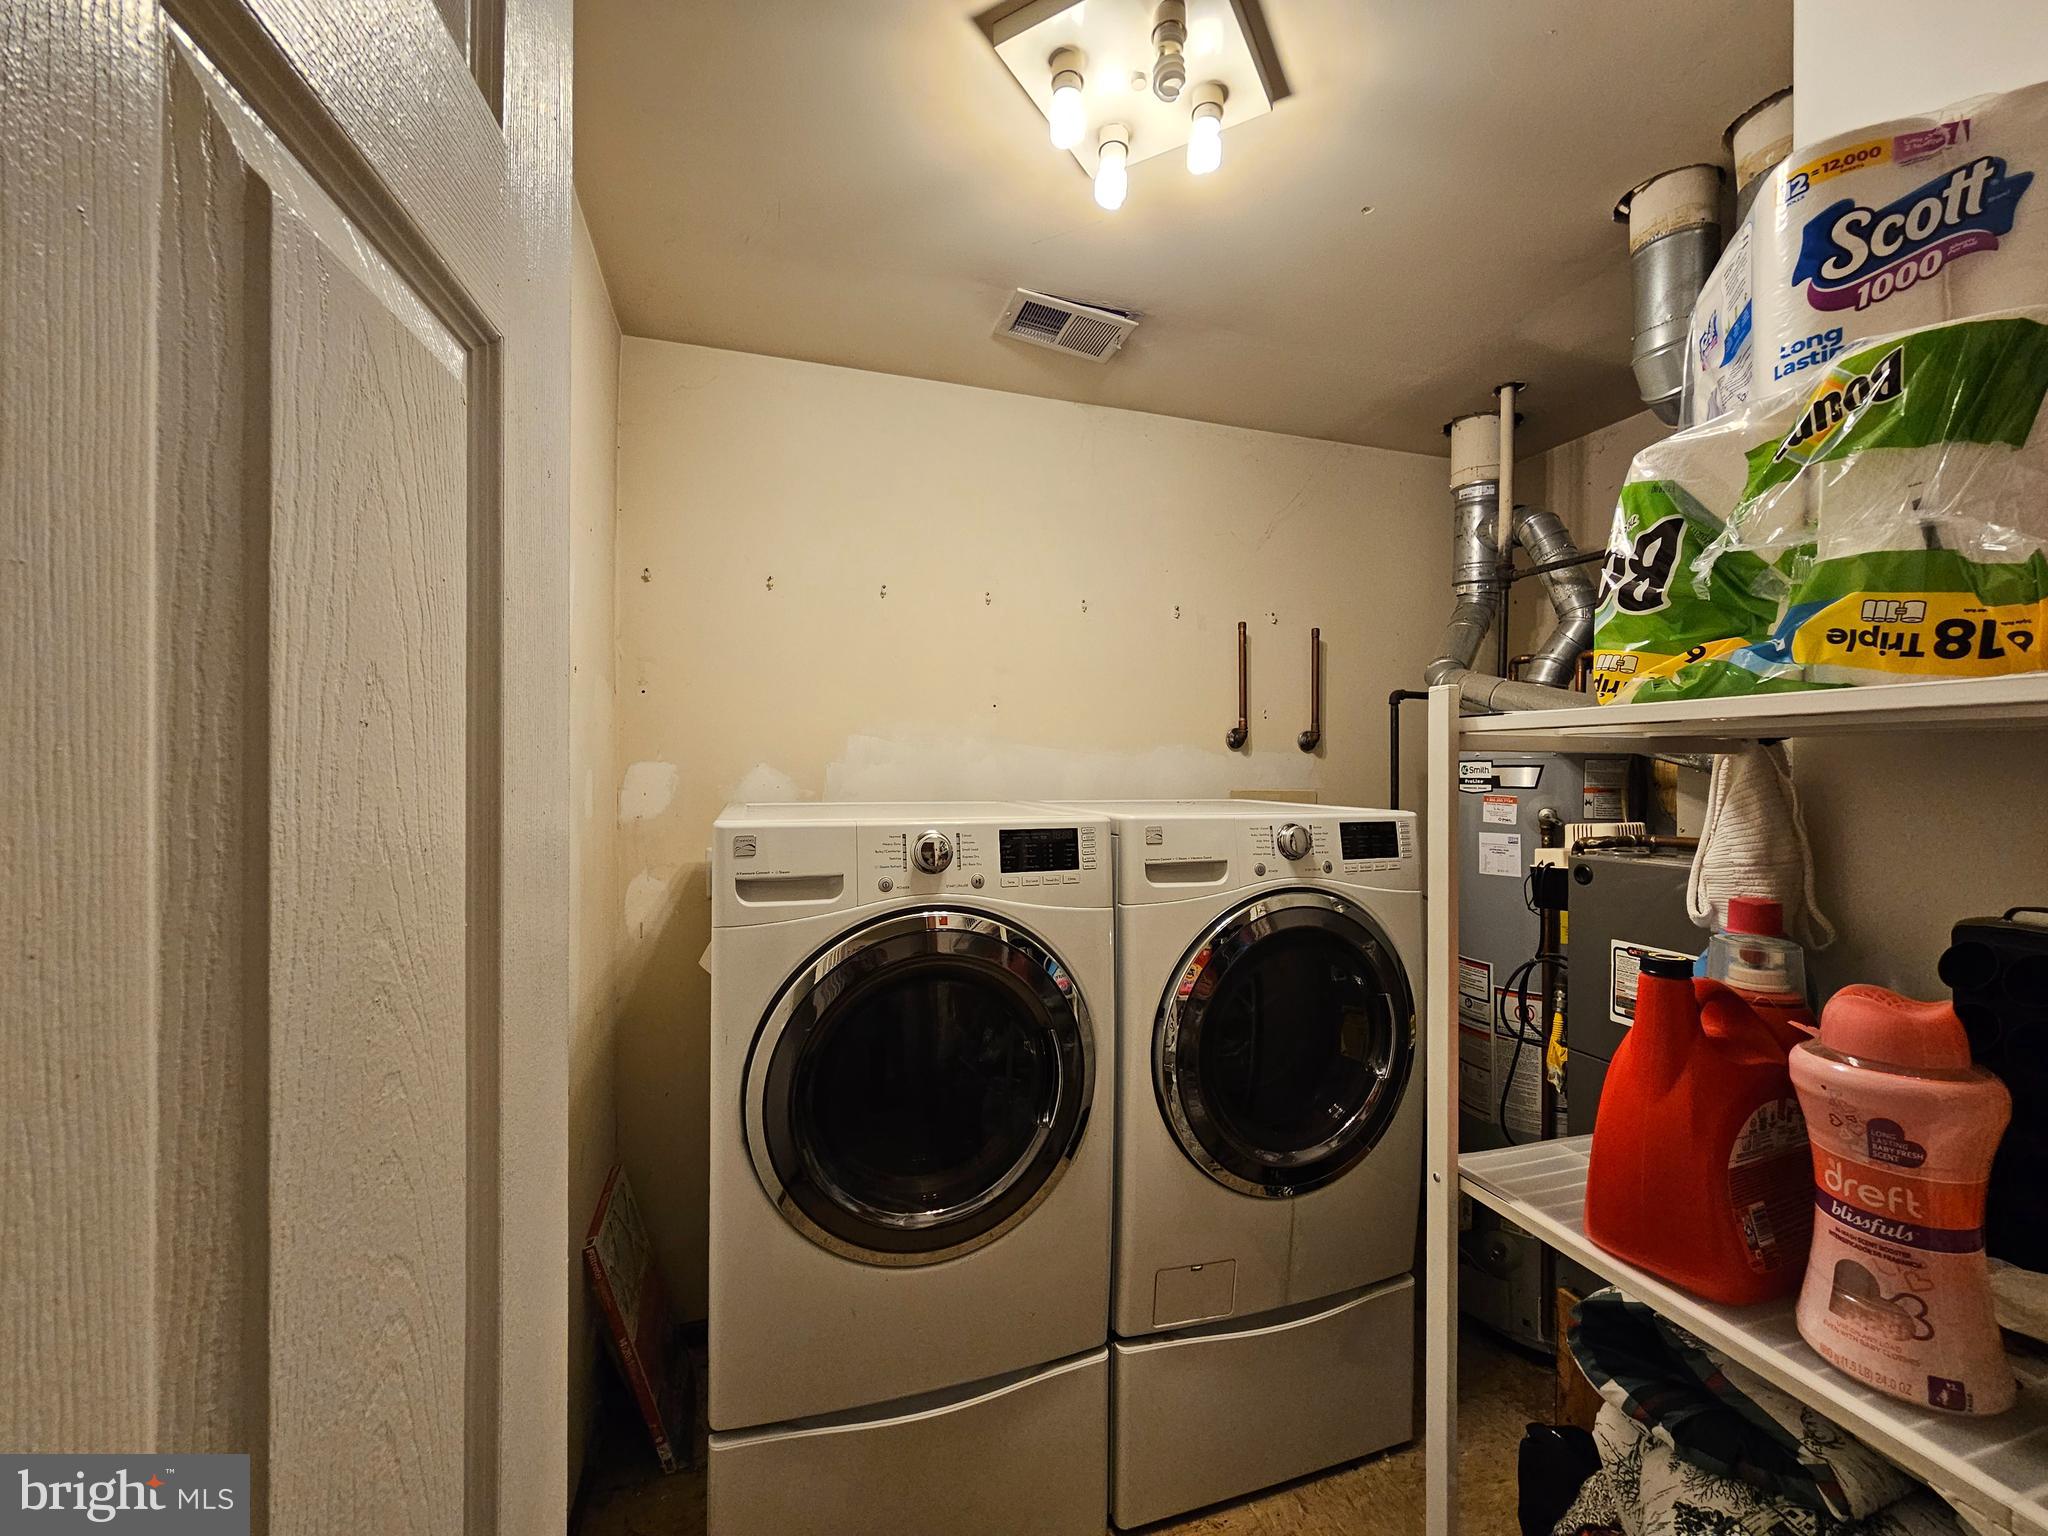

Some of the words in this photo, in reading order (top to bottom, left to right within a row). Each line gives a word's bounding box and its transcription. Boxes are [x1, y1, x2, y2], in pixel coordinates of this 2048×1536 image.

[1821, 145, 1882, 173] 12,000
[1820, 157, 1996, 281] Scott
[1855, 249, 1943, 310] 1000
[1780, 326, 1843, 359] Long
[1826, 625, 1925, 658] Triple
[1933, 618, 2006, 660] 18
[1469, 766, 1490, 774] Smith
[1870, 1128, 1897, 1141] LONG
[1872, 1138, 1909, 1151] LASTING
[1872, 1143, 1895, 1155] BABY
[1897, 1149, 1924, 1161] FRESH
[1872, 1150, 1898, 1163] SCENT
[1824, 1157, 1926, 1219] dreft
[1831, 1200, 1914, 1242] blissfuls
